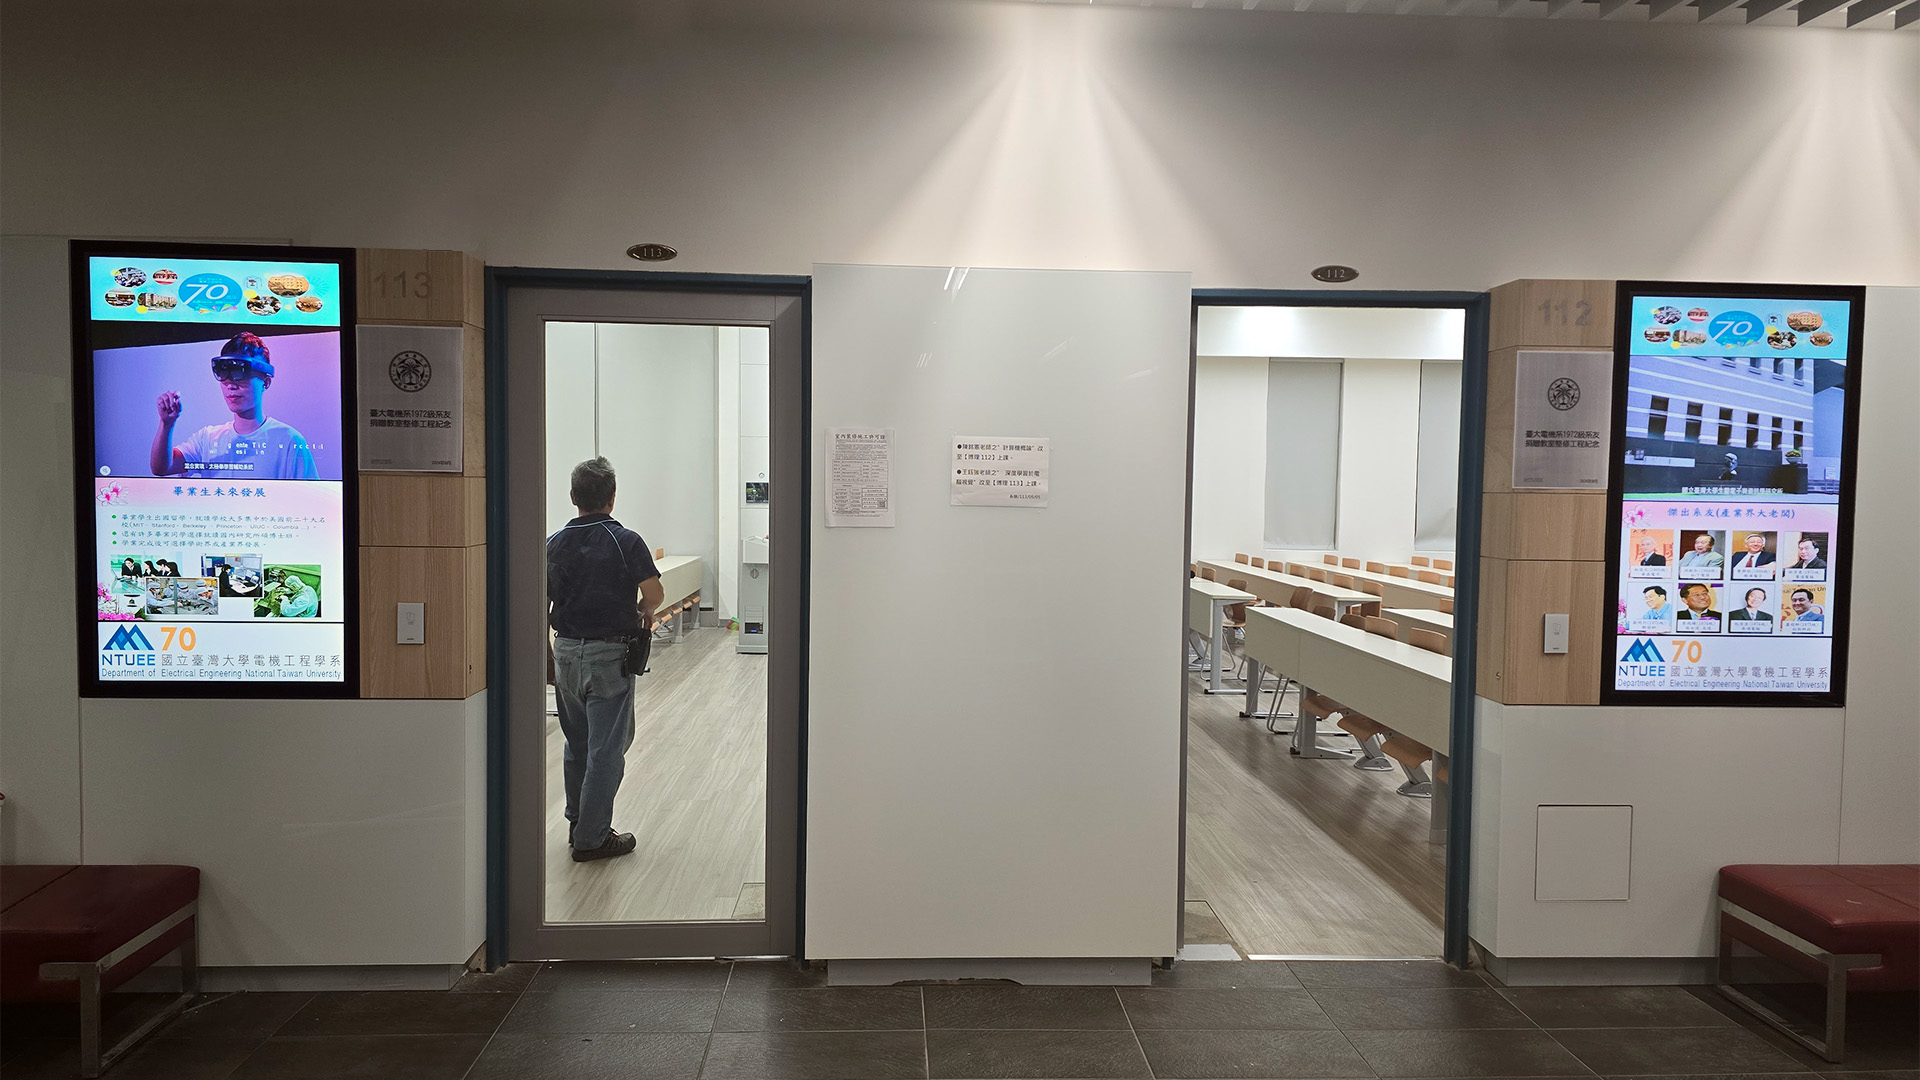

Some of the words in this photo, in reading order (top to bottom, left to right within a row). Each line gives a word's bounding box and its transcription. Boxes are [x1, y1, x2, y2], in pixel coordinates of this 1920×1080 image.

[644, 248, 662, 257] 113
[1327, 269, 1345, 278] 112
[373, 270, 433, 299] 113
[183, 283, 229, 305] 70
[1538, 300, 1593, 327] 112
[1712, 320, 1753, 341] 70
[173, 486, 267, 498] 畢業生未來發展
[160, 626, 197, 651] 70
[1671, 640, 1703, 663] 70
[102, 653, 156, 667] NTUEE
[162, 653, 341, 667] 國立臺灣大學電機工程學系
[101, 668, 145, 679] Department
[148, 668, 156, 677] of
[161, 668, 196, 677] Electrical
[199, 668, 242, 679] Engineering
[245, 668, 276, 678] National
[277, 669, 303, 678] Taiwan
[306, 669, 342, 680] University
[1618, 665, 1666, 677] NTUEE
[1670, 665, 1828, 679] 國立臺灣大學電機工程學系
[1617, 678, 1656, 689] Department
[1658, 679, 1666, 687] of
[1669, 679, 1701, 688] Electrical
[1703, 679, 1741, 690] Engineering
[1743, 680, 1770, 688] National
[1771, 680, 1795, 689] Taiwan
[1797, 680, 1828, 690] University
